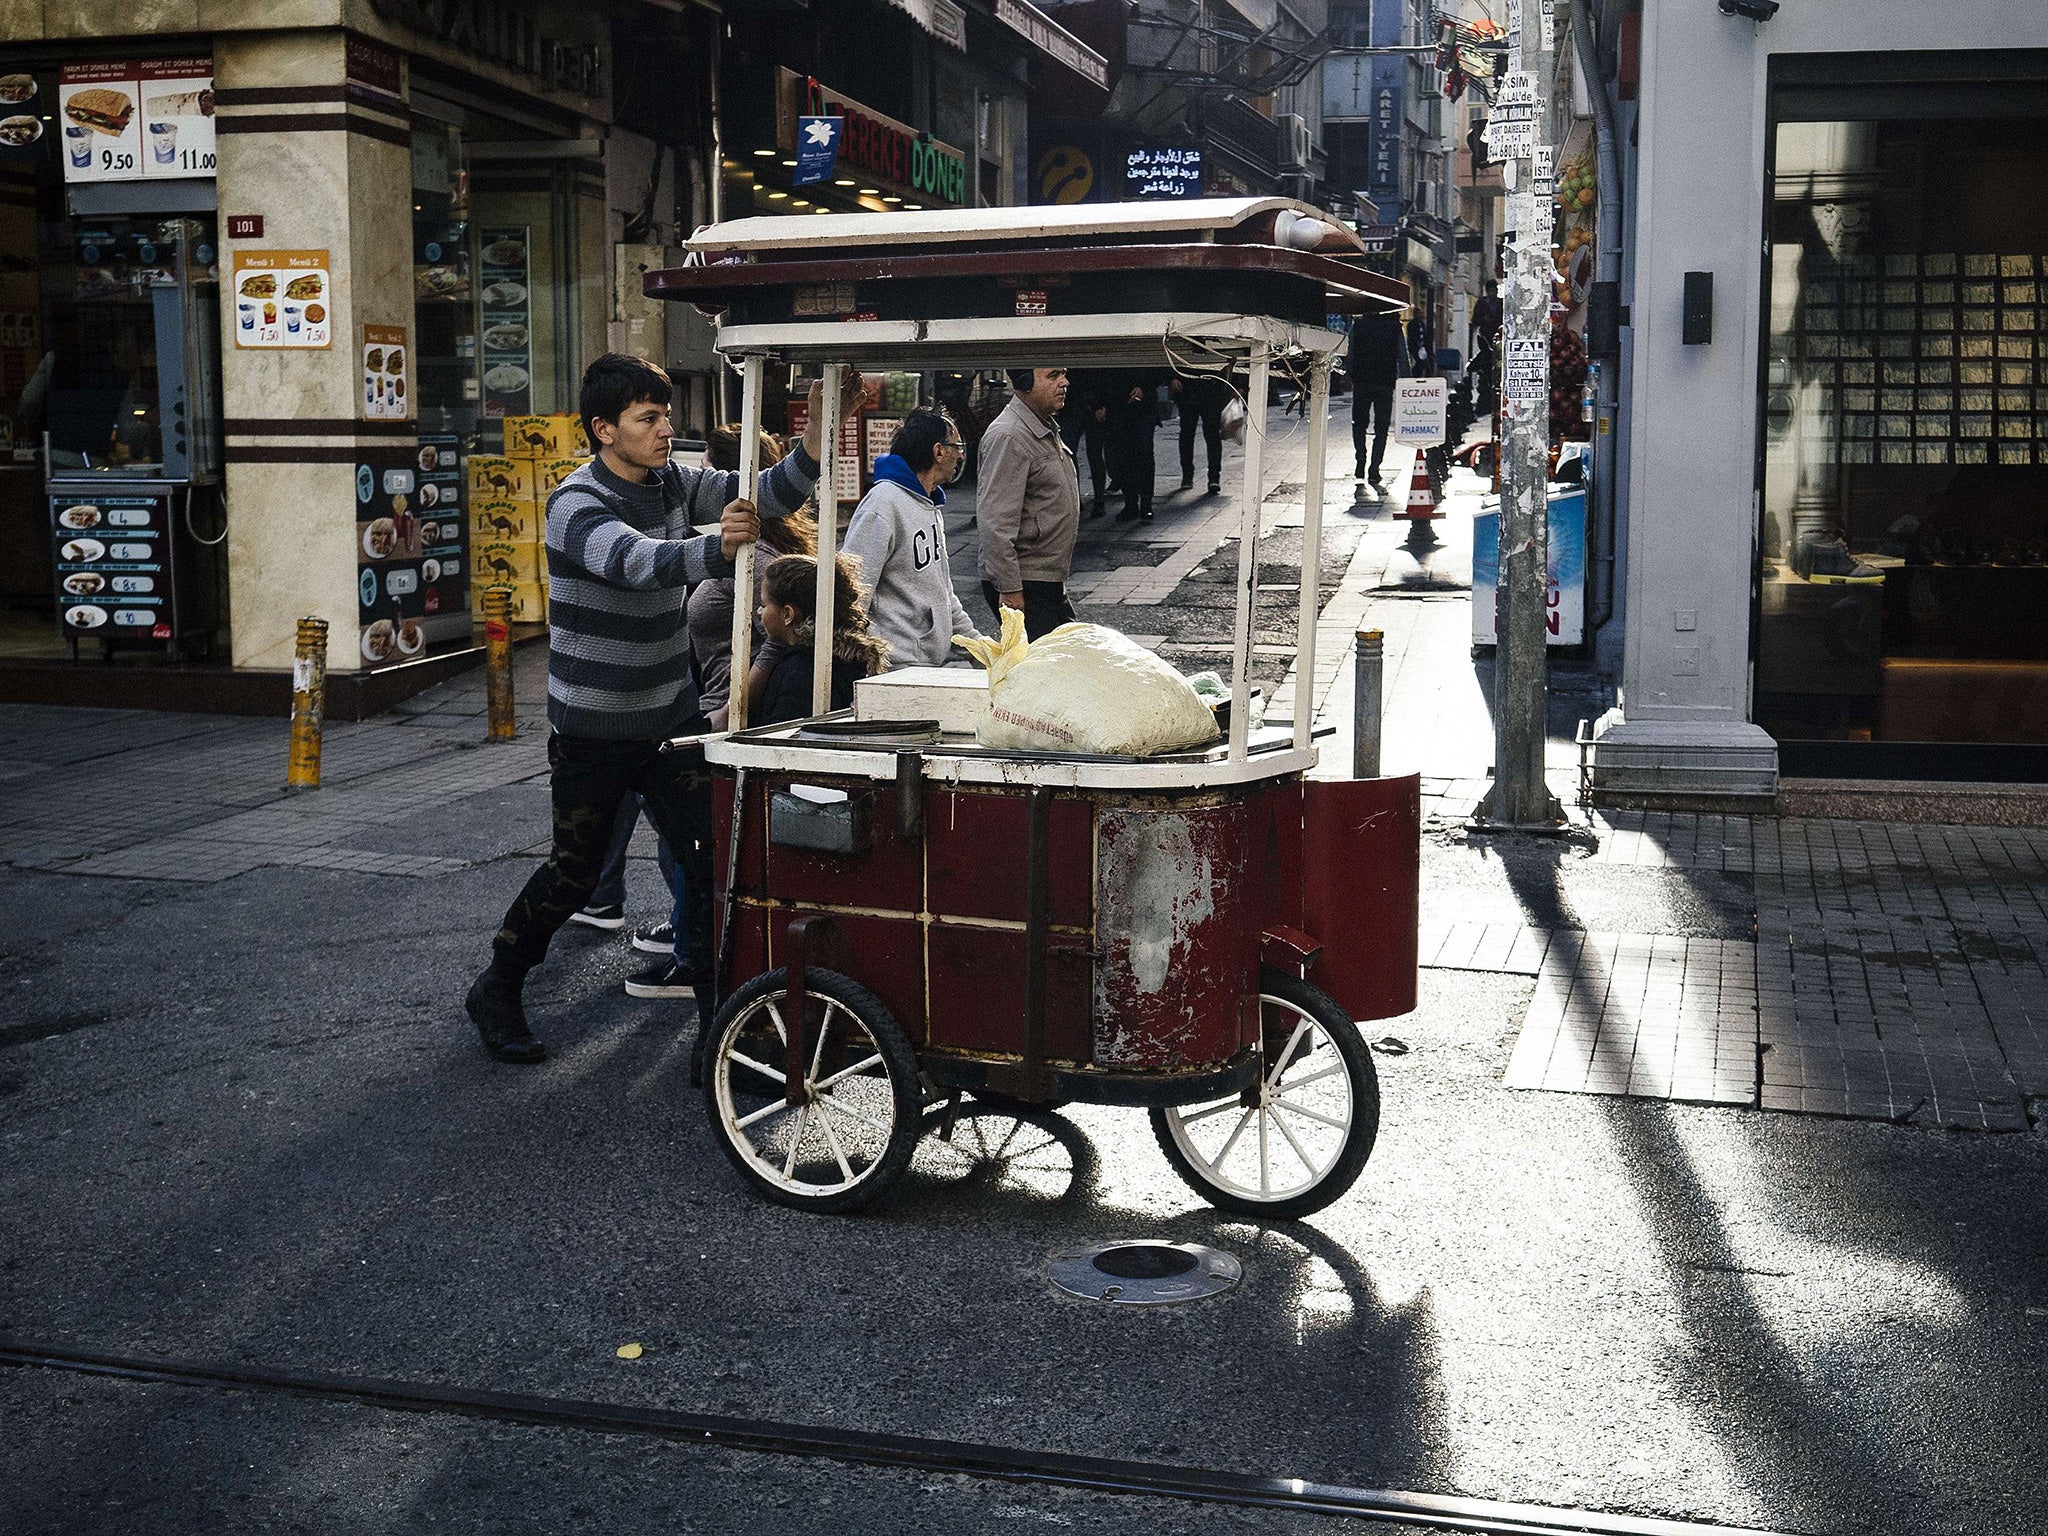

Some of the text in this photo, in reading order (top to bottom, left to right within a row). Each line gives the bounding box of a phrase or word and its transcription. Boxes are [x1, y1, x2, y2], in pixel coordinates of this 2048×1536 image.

[102, 150, 134, 171] 9.50
[180, 149, 216, 170] 11.00
[912, 131, 965, 205] DÖNER
[236, 221, 255, 233] 101
[245, 258, 268, 266] Menü
[288, 259, 311, 267] Menü
[259, 328, 279, 341] 7.50
[306, 328, 325, 341] 7.50
[1511, 342, 1543, 351] FAL
[1401, 389, 1440, 397] ECZANE
[1401, 425, 1439, 434] PHARMACY
